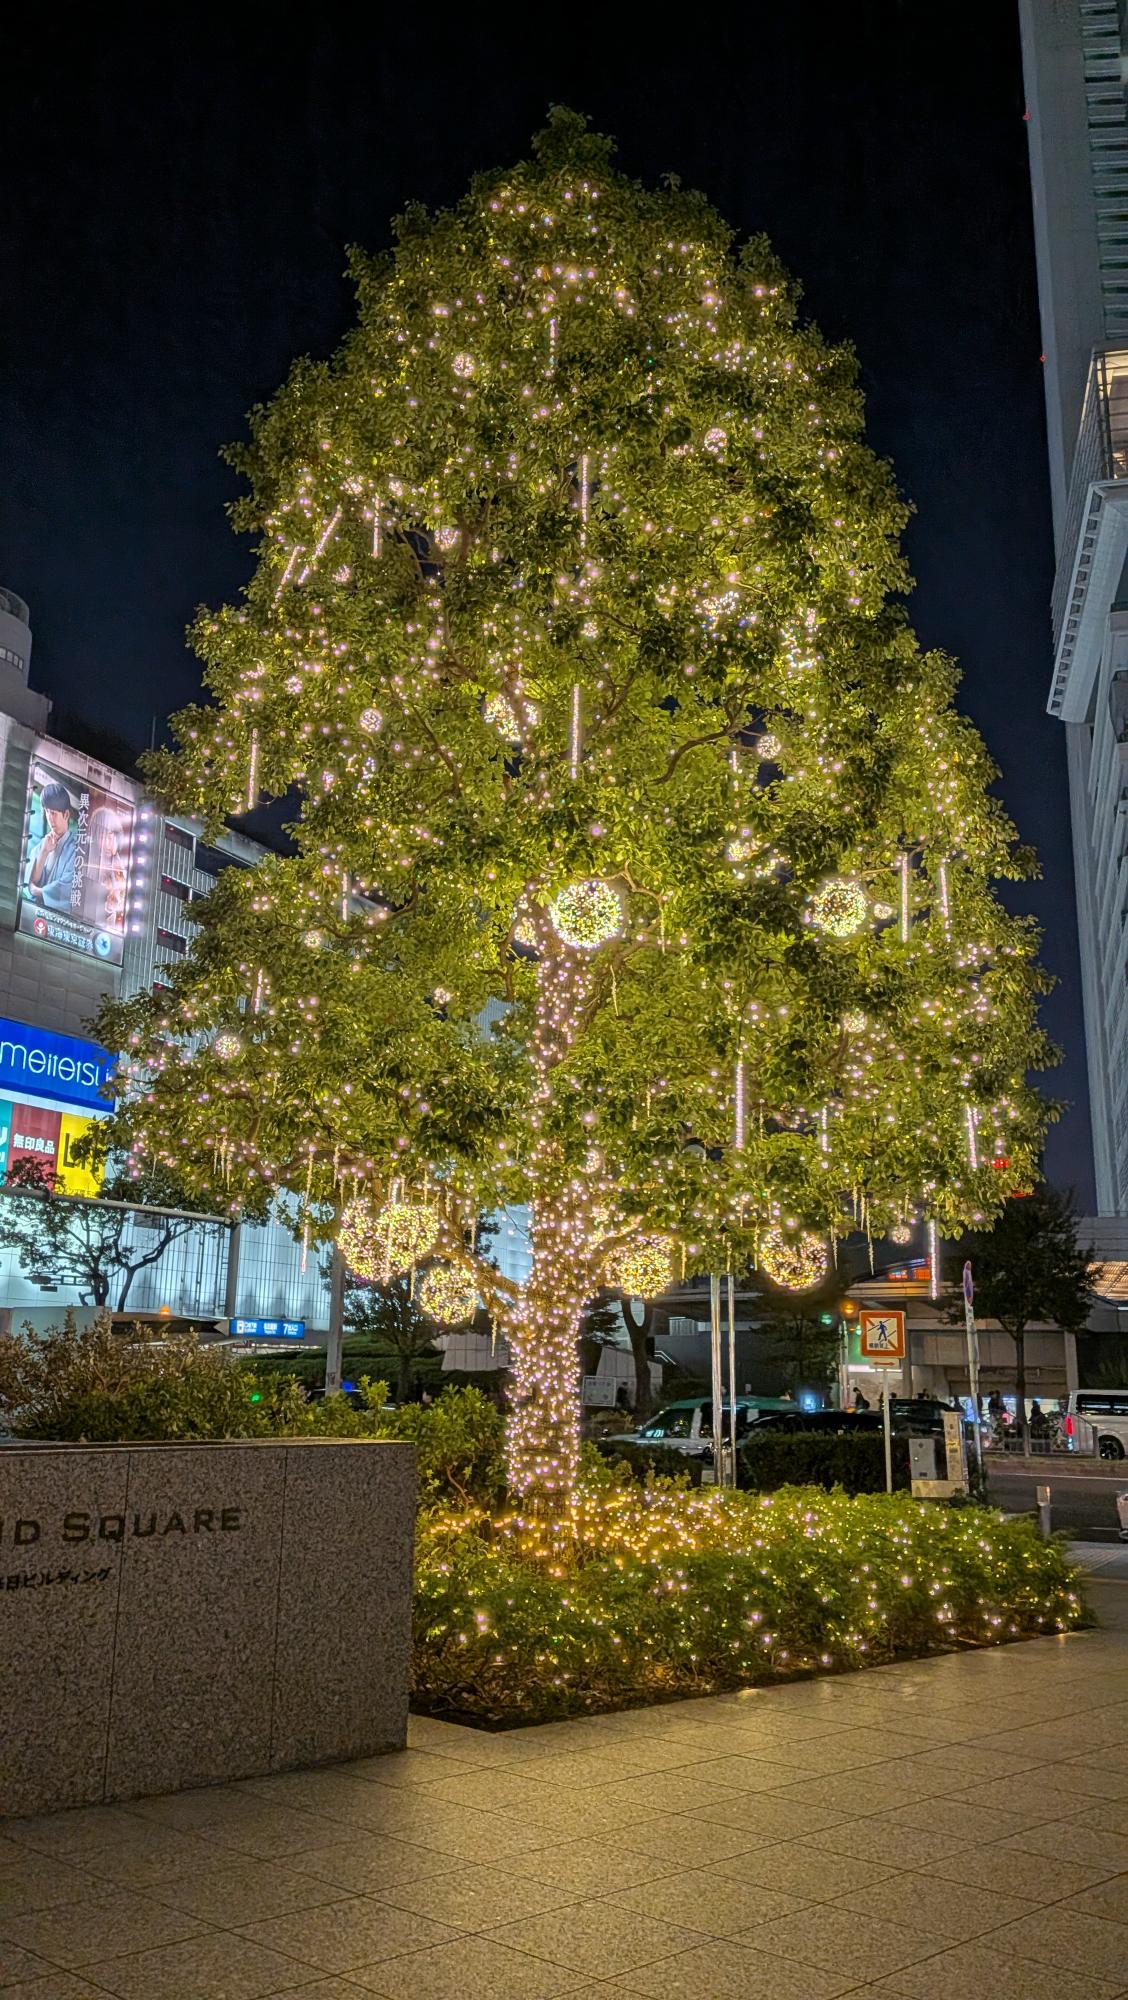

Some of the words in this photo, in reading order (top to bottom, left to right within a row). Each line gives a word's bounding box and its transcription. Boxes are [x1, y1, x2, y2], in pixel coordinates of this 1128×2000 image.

[70, 793, 90, 907] 異次元への挑戦
[13, 1133, 55, 1155] 無印良品
[62, 1507, 241, 1543] SQUARE
